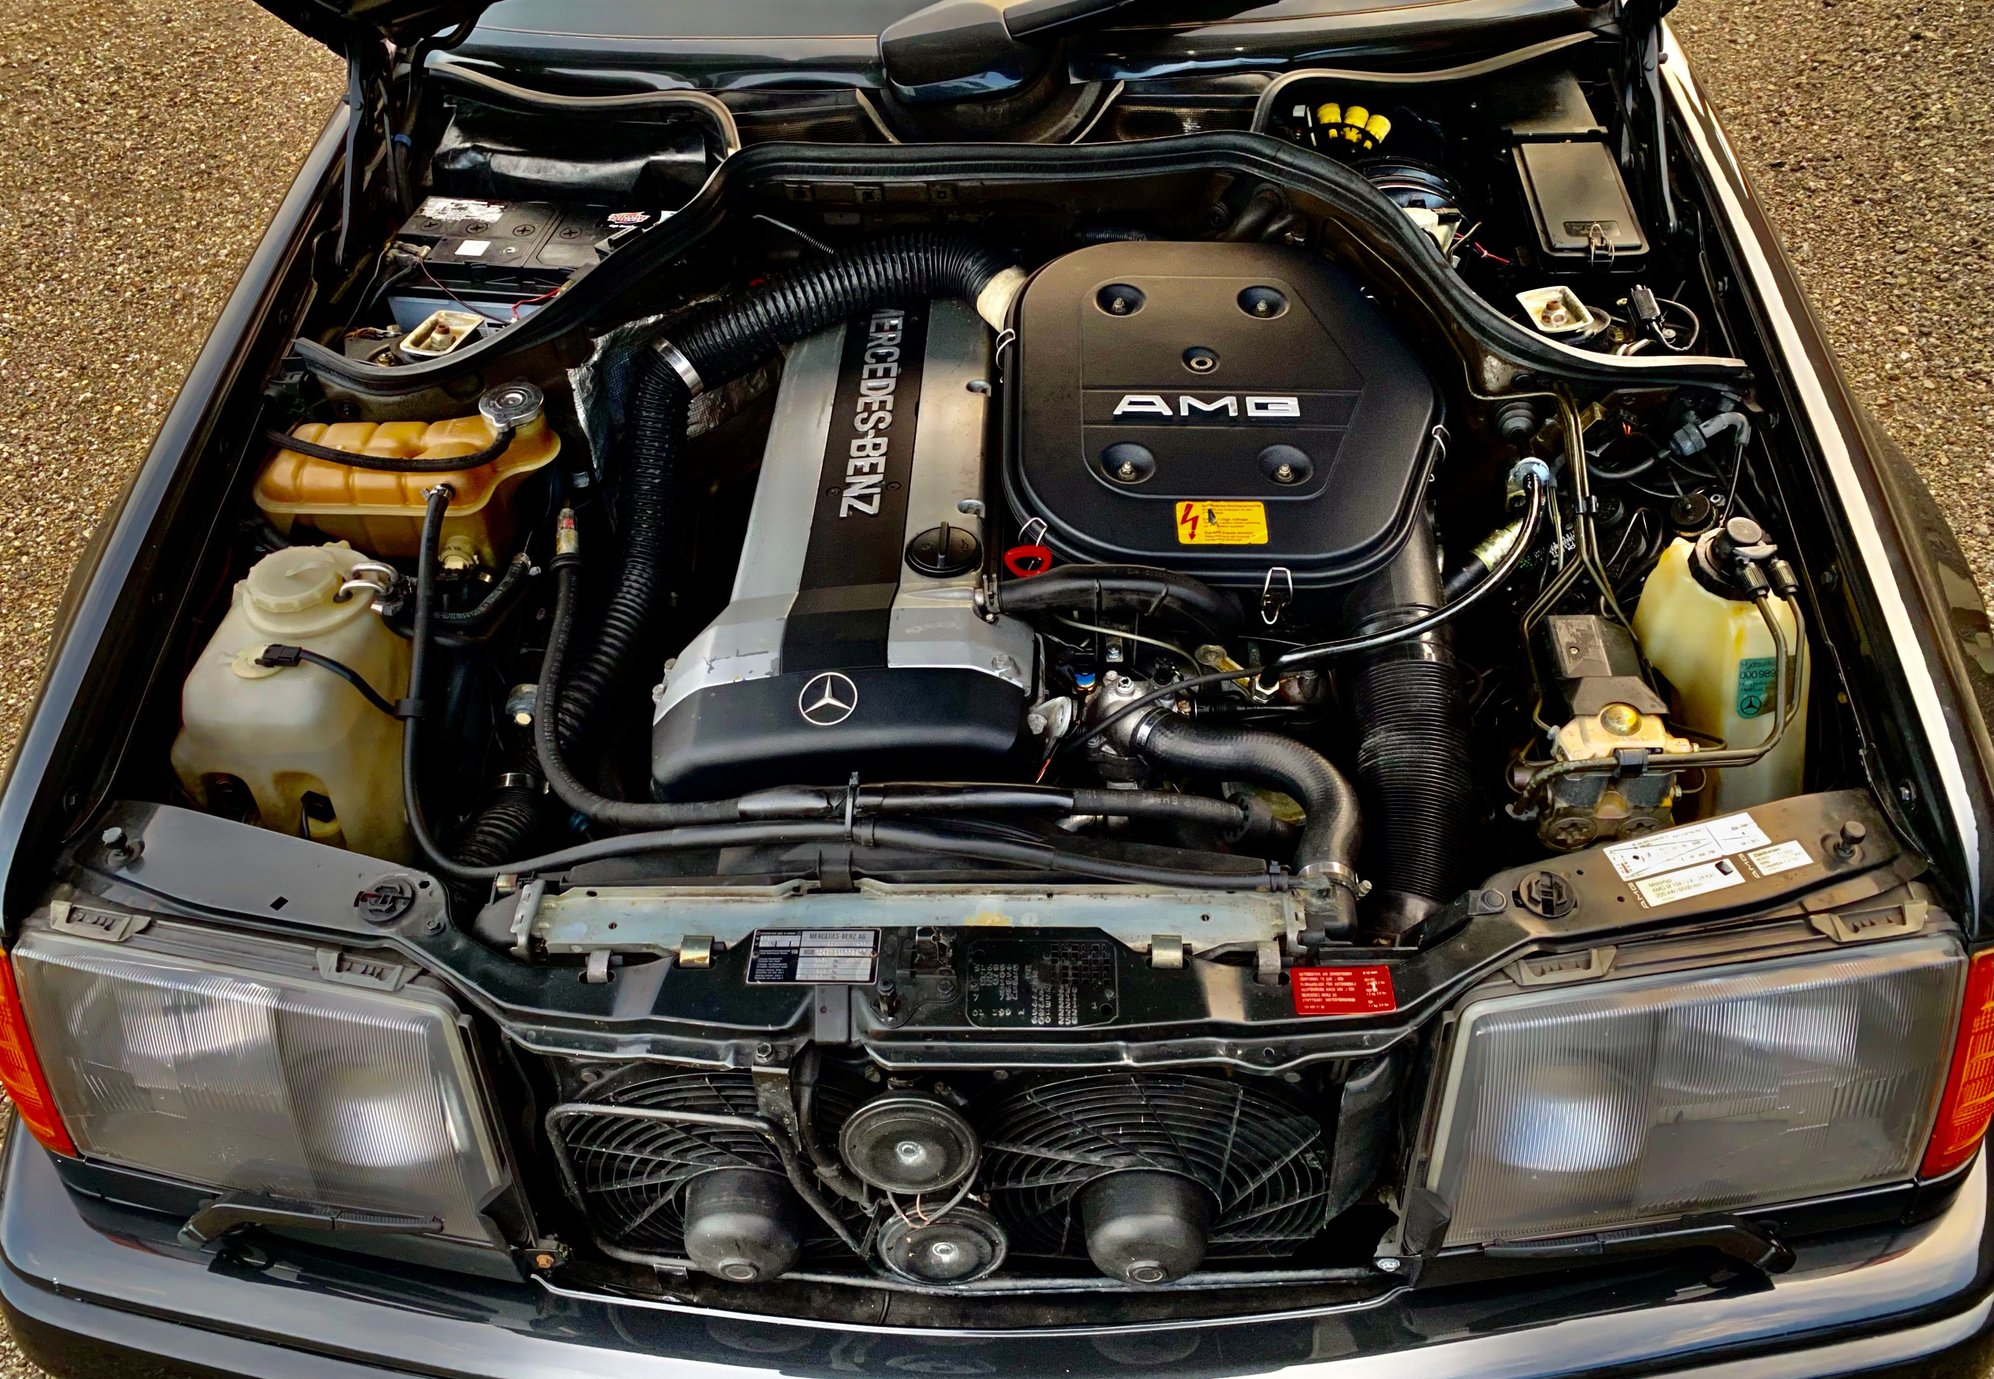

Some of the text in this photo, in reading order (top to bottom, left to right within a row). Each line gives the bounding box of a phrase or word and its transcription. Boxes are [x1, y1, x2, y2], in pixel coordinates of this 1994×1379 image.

[1113, 395, 1300, 417] AMG
[1740, 670, 1758, 679] 000
[1738, 853, 1761, 879] AMG
[1628, 881, 1650, 909] AMG
